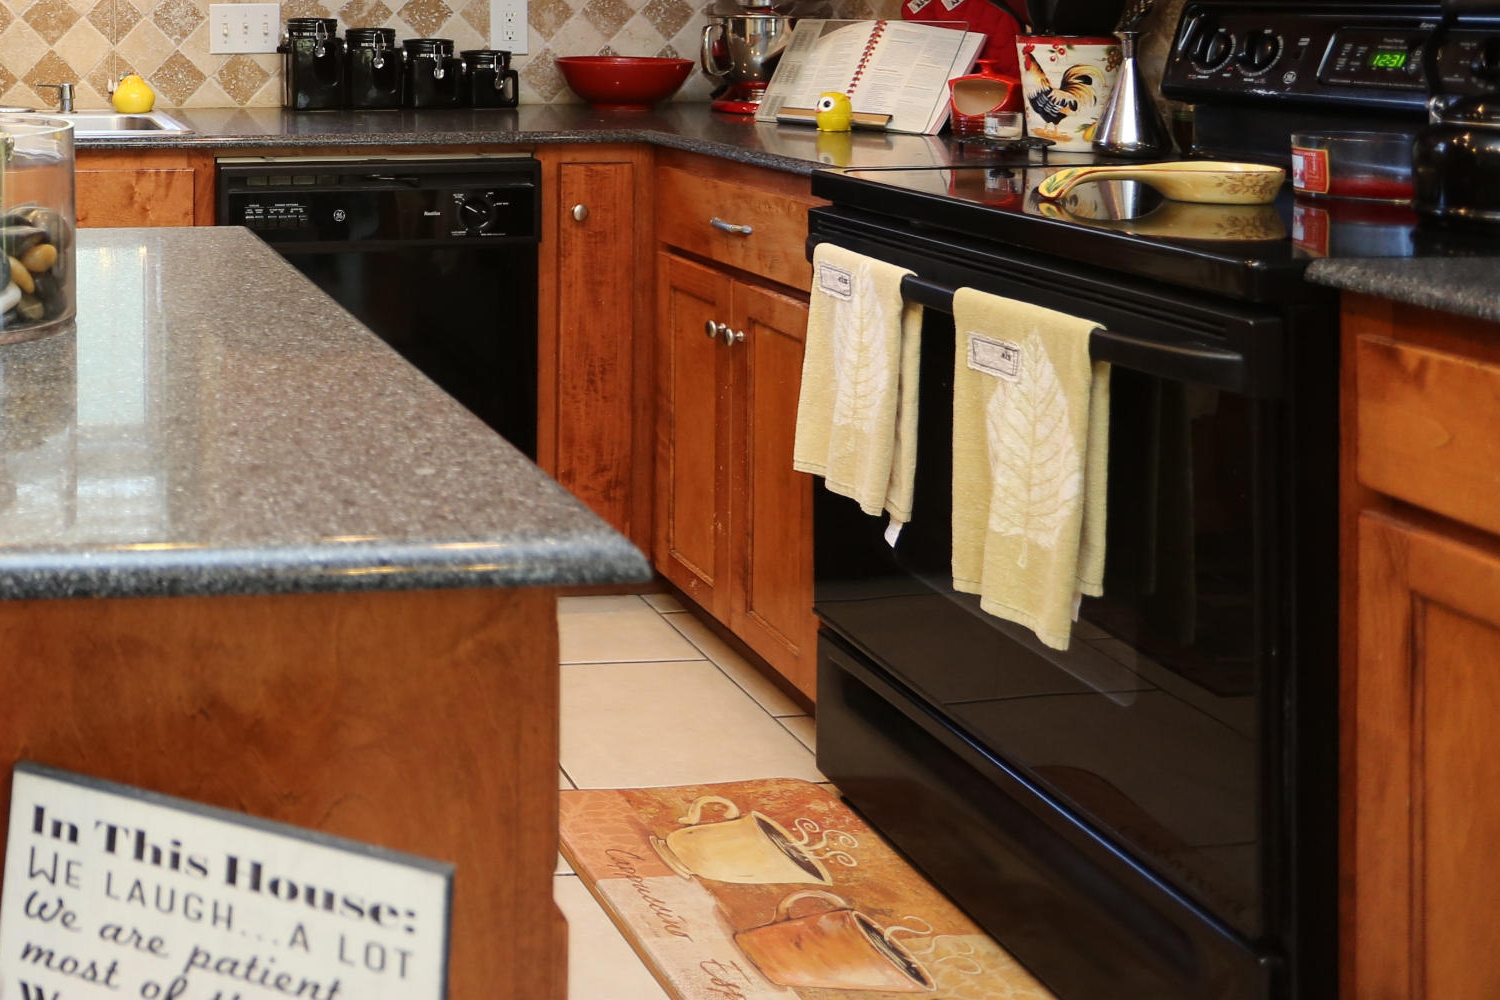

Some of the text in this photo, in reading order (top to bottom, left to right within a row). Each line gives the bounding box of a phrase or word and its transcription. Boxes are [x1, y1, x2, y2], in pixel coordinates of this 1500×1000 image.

[1373, 54, 1407, 68] 12:31
[28, 845, 83, 890] WE
[338, 932, 414, 980] LOT
[32, 804, 416, 934] In This House:
[20, 941, 120, 991] most
[24, 890, 341, 1000] We are patient
